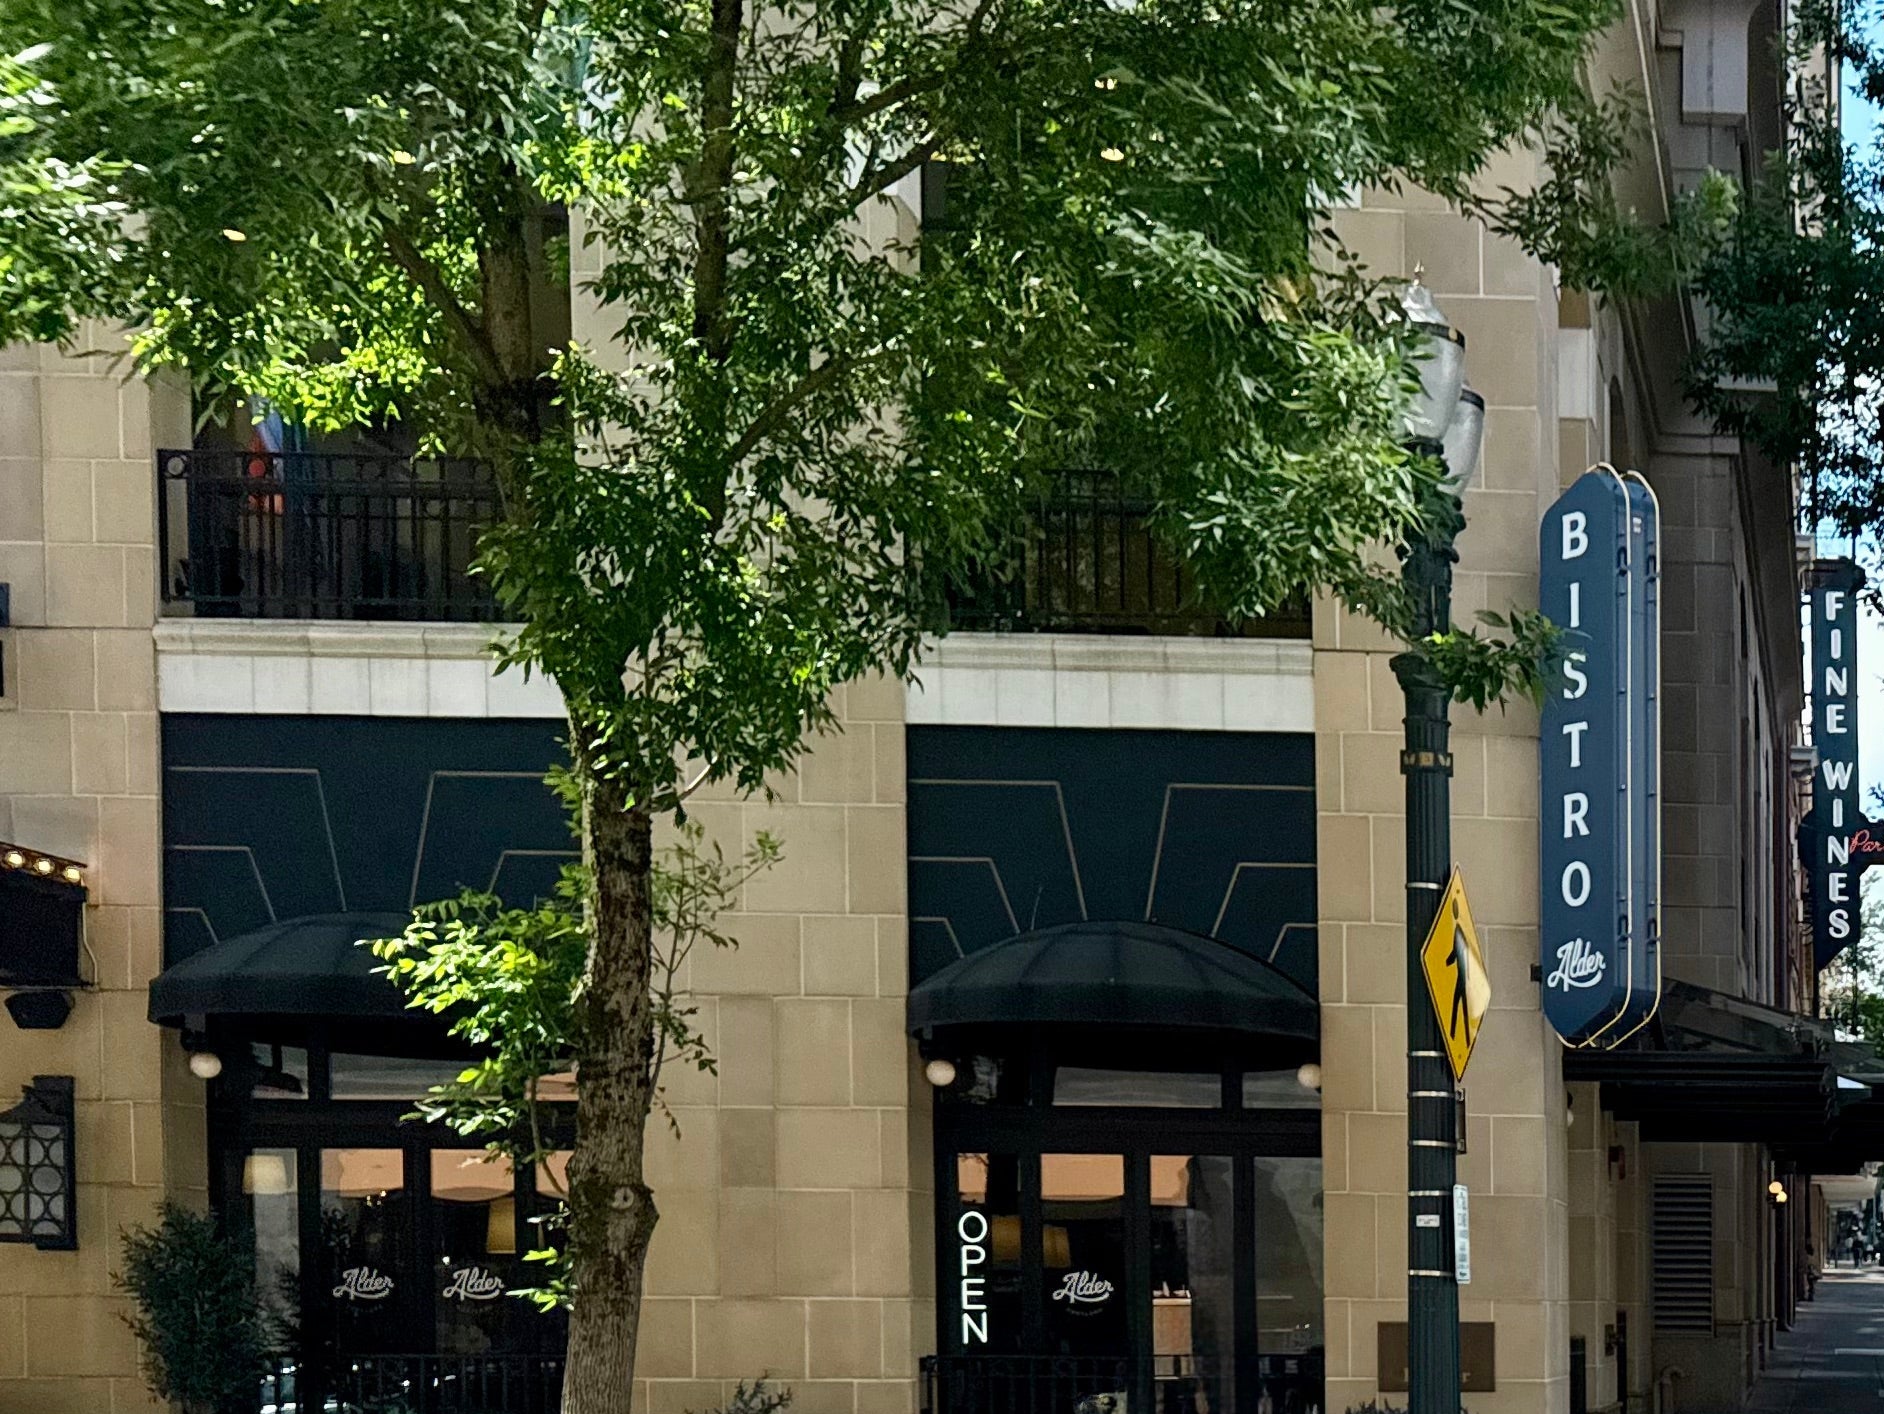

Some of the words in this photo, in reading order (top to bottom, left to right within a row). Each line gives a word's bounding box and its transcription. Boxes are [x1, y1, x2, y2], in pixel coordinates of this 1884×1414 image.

[1561, 511, 1592, 908] BISTRO
[1824, 591, 1848, 735] FINE
[1822, 759, 1853, 940] WINES
[1547, 937, 1606, 992] Alder
[332, 1266, 395, 1300] Alder
[442, 1266, 505, 1300] Alder
[958, 1210, 988, 1345] OPEN
[1052, 1270, 1115, 1304] Alder
